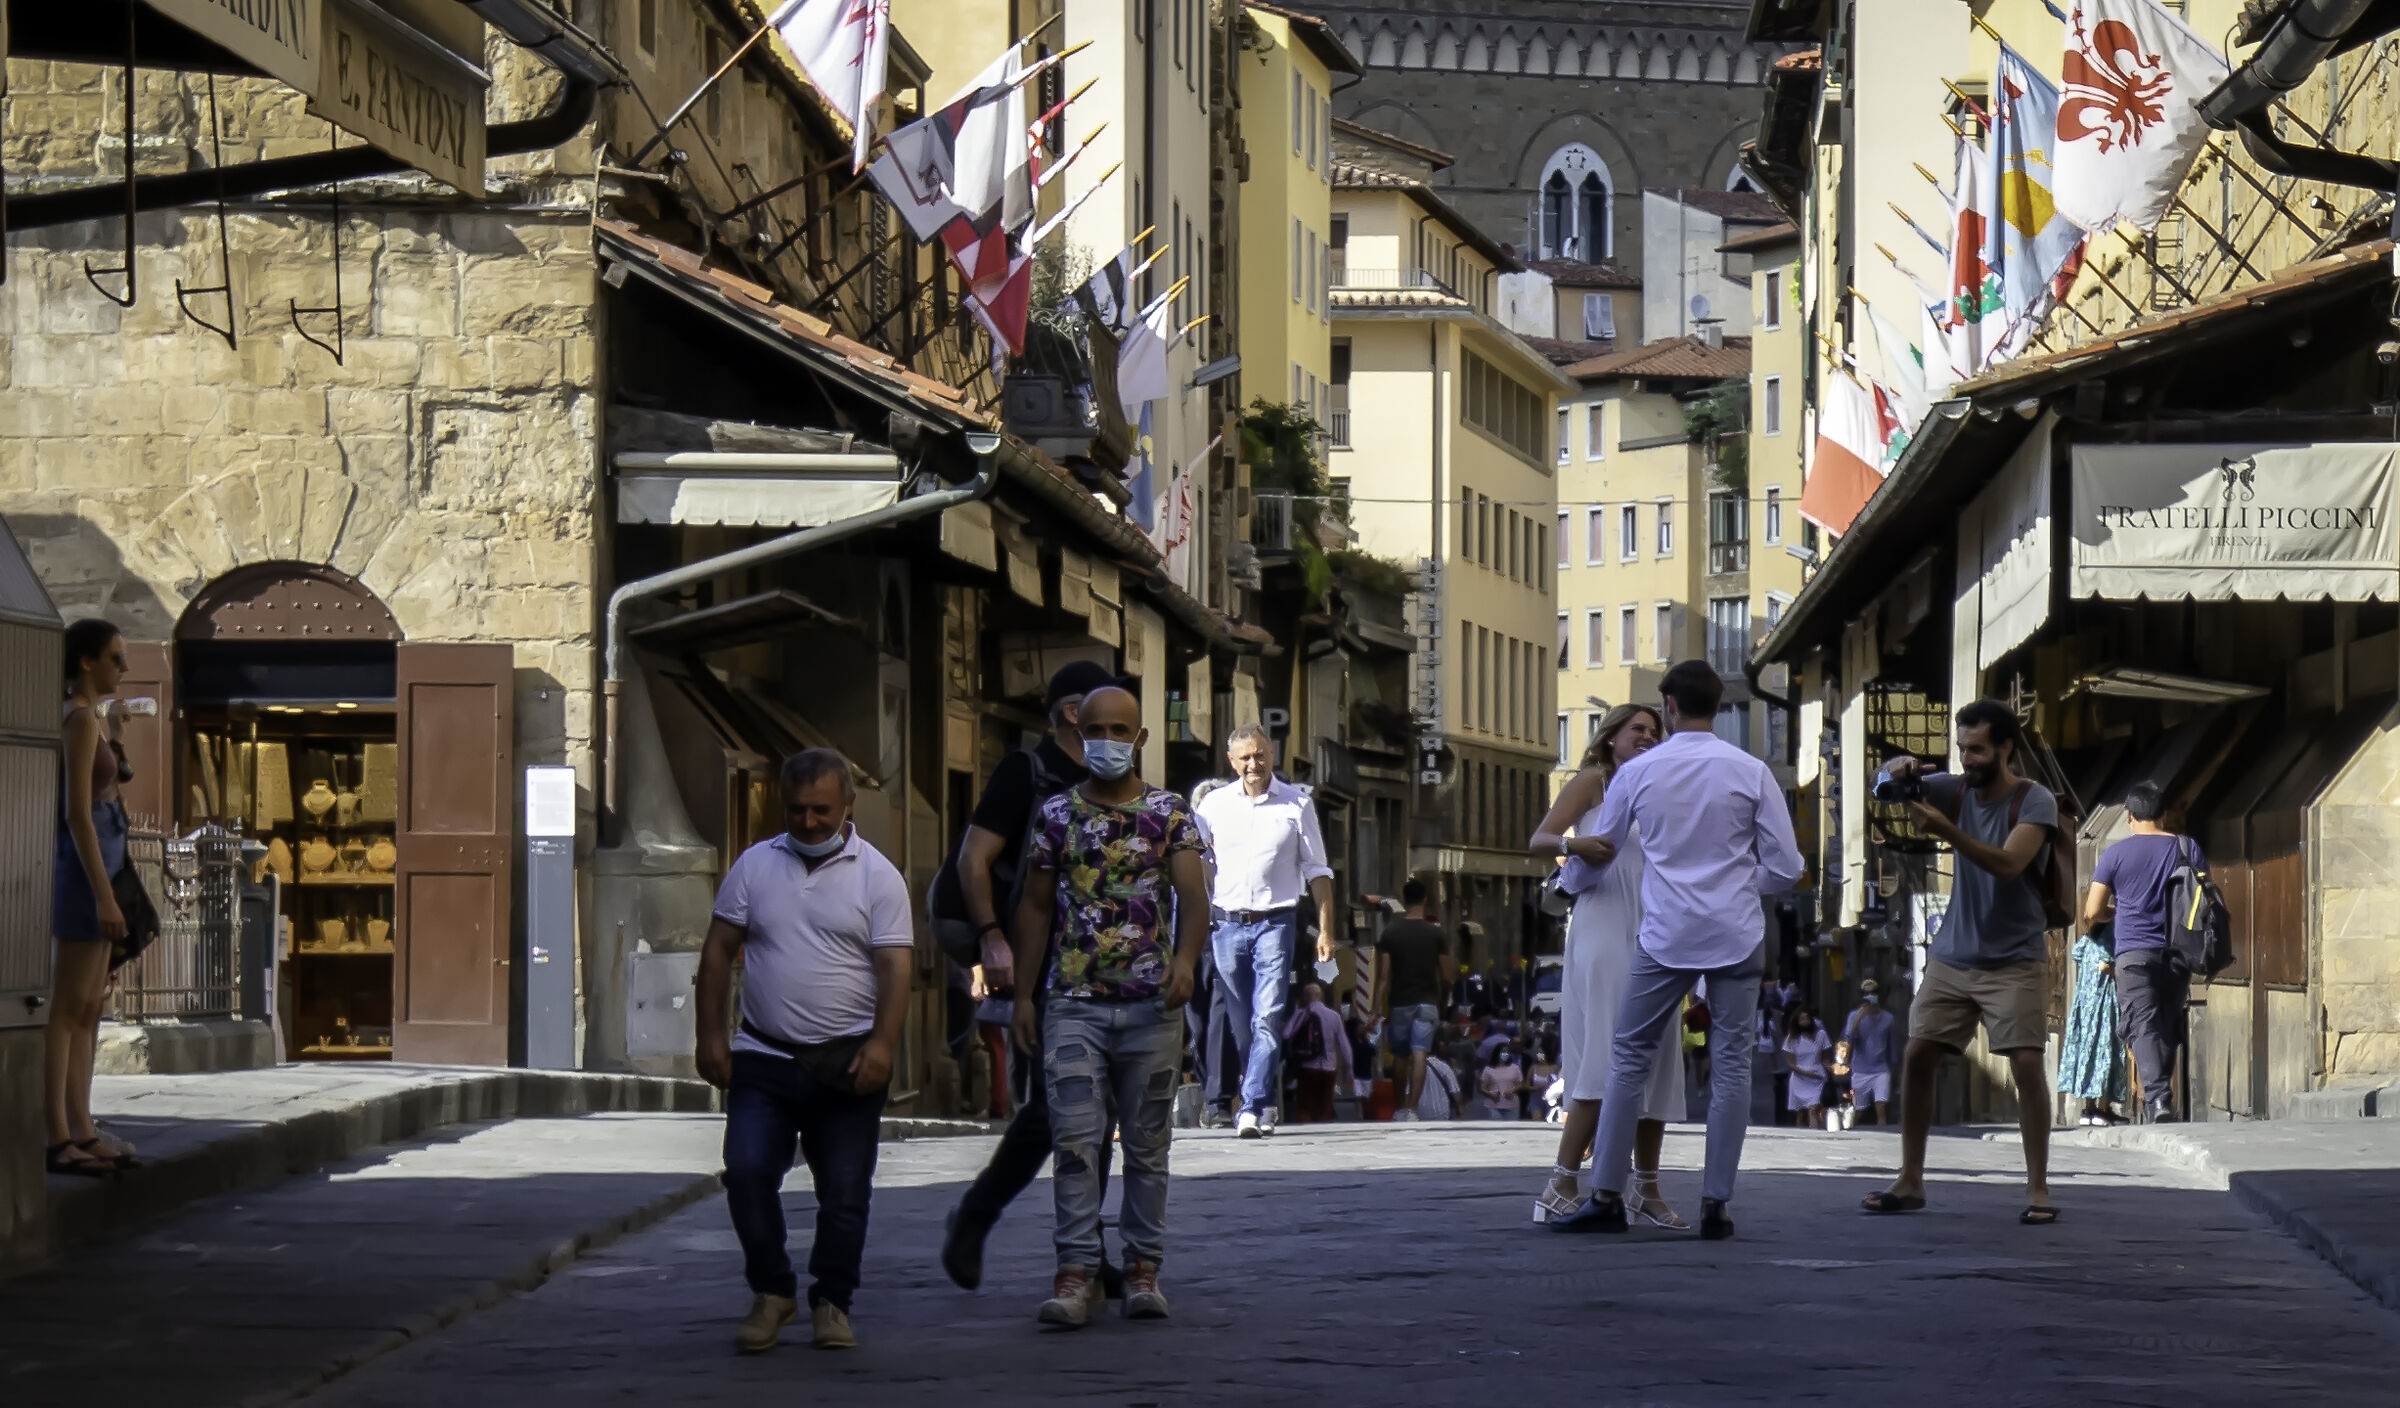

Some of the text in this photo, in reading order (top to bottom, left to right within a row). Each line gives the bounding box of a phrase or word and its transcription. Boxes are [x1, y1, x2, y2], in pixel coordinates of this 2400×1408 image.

[338, 29, 469, 169] E. FANTONI
[2100, 506, 2377, 530] FRATELLI PICCINI
[2210, 535, 2266, 547] FIRENZE
